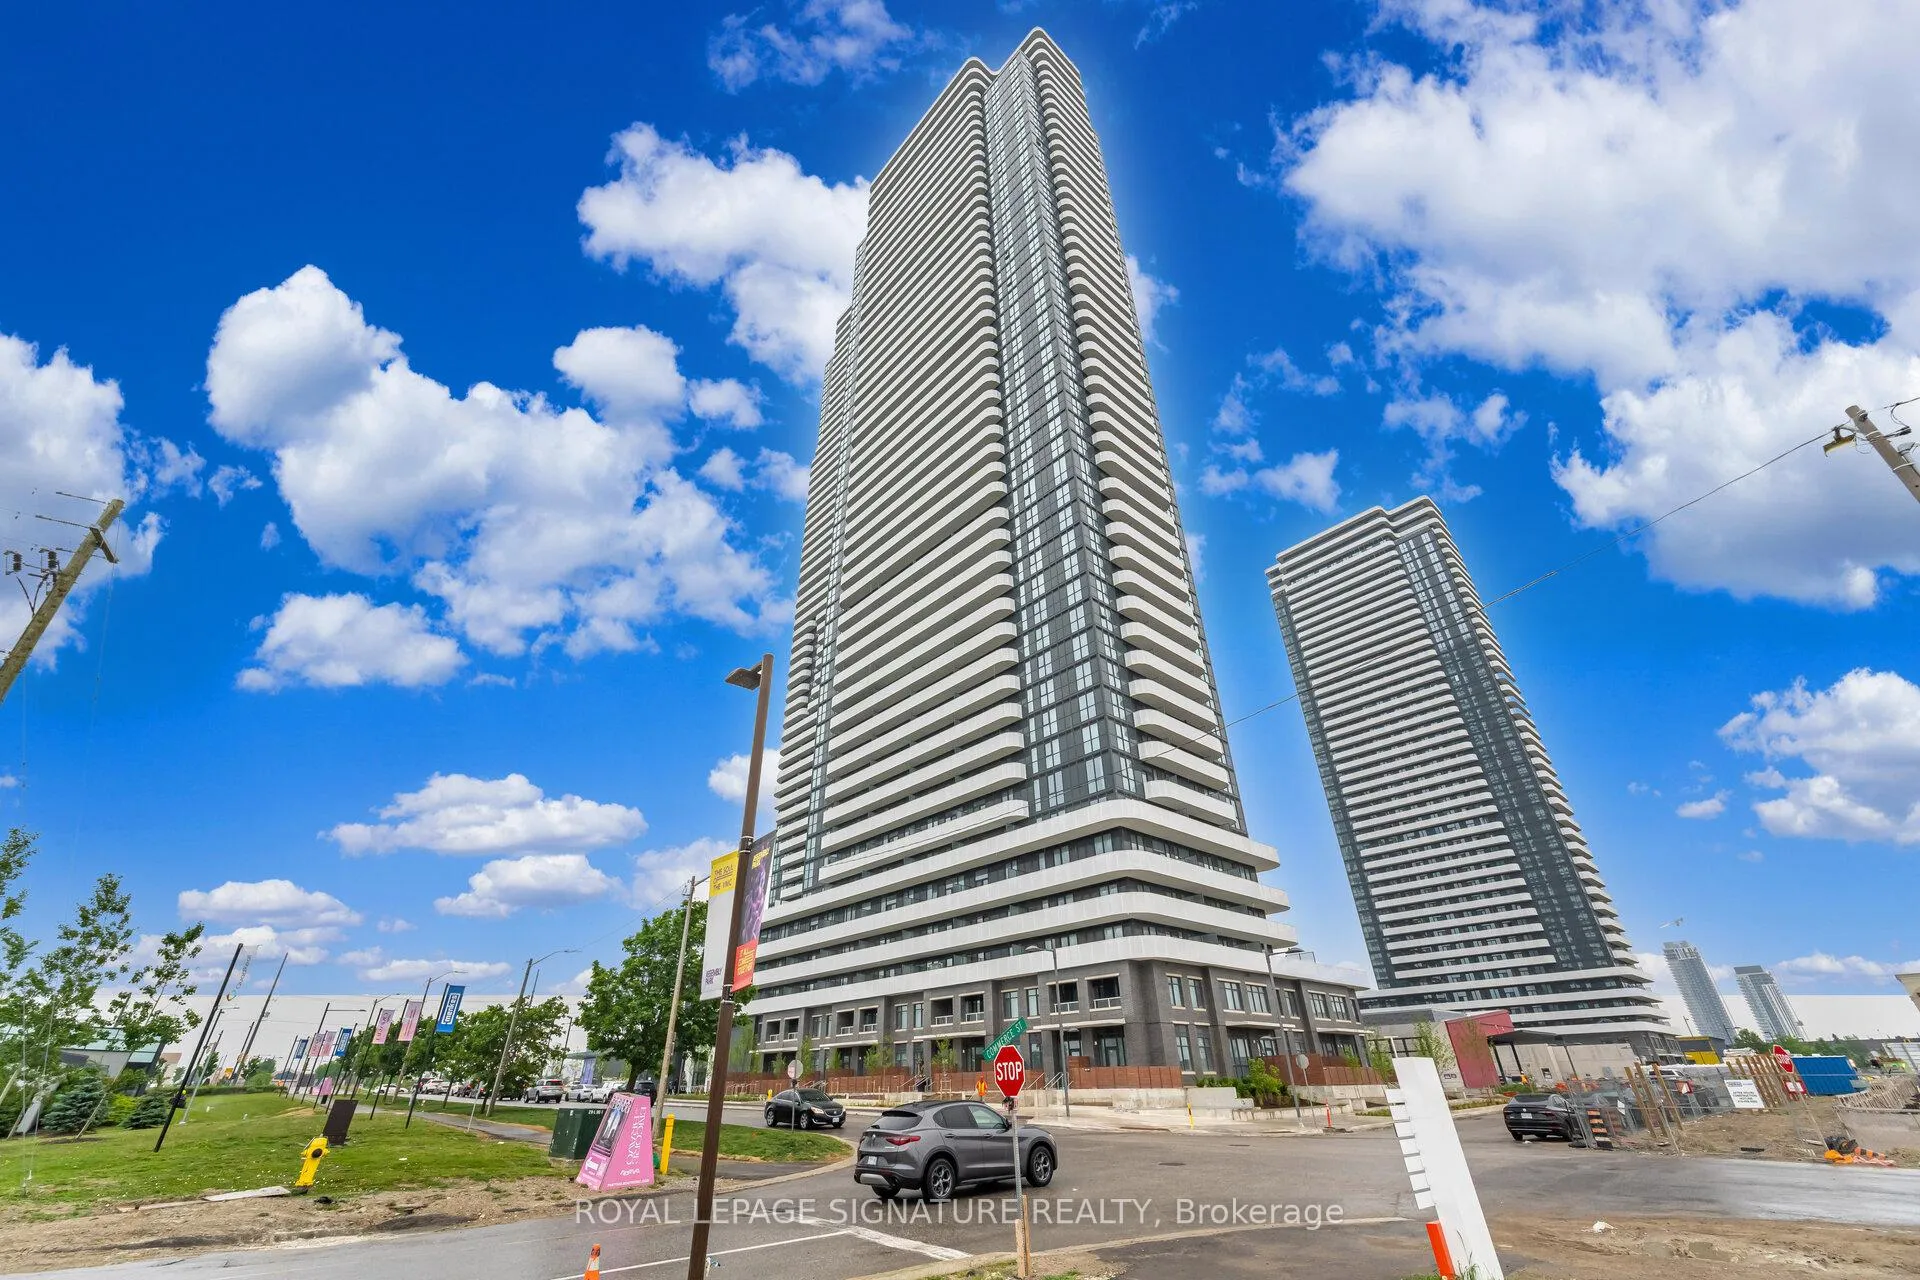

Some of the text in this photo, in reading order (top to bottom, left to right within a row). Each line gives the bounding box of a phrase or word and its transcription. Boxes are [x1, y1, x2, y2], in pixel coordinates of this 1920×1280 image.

[444, 994, 458, 1023] menkes
[986, 1021, 1024, 1059] COMMERCE ST
[996, 1061, 1022, 1081] STOP
[1774, 1053, 1791, 1066] STOP
